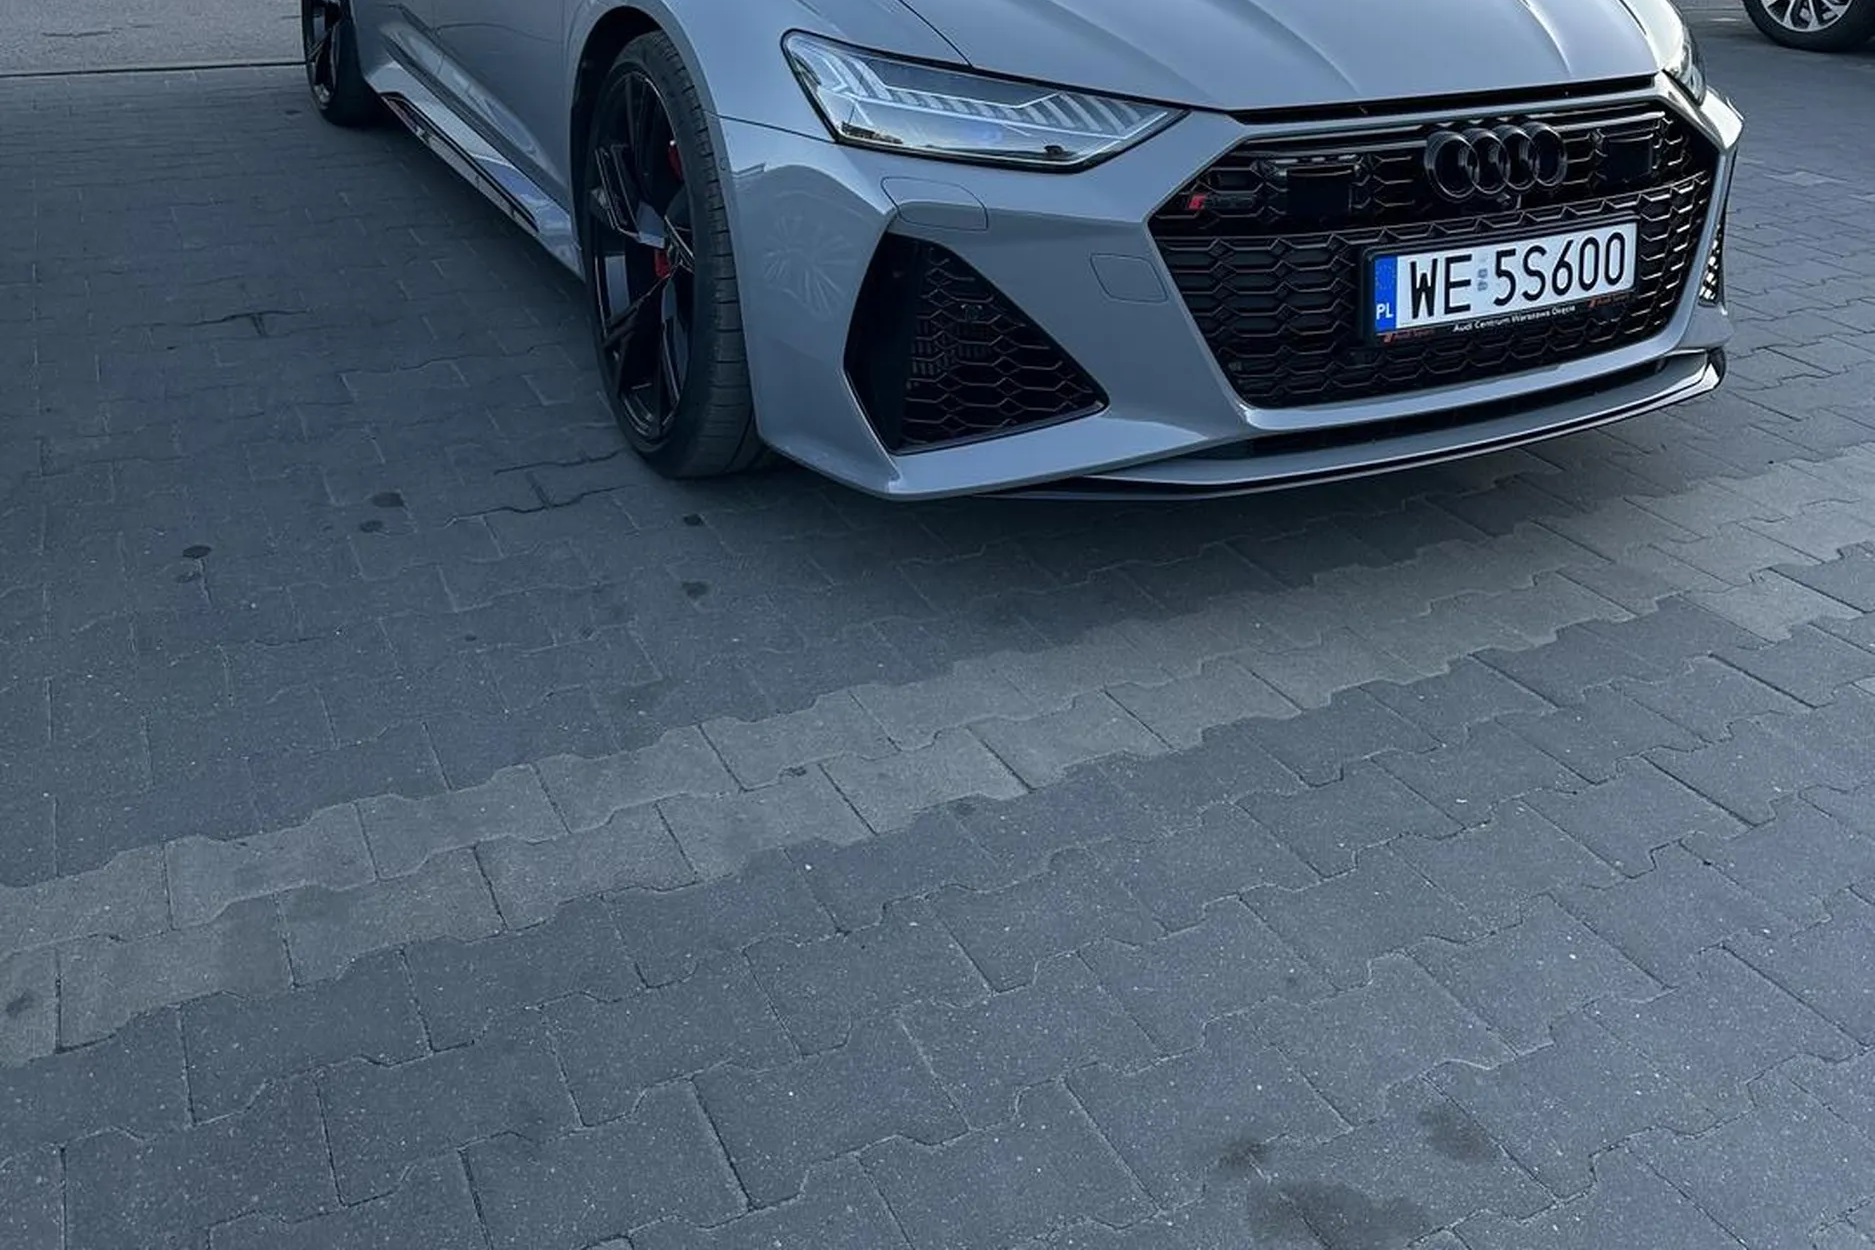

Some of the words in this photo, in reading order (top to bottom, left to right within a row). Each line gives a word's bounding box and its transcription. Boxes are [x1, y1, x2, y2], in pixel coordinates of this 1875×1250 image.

[1376, 302, 1395, 320] PL
[1409, 252, 1473, 320] WE
[1493, 231, 1626, 307] 5S600
[1452, 322, 1473, 333] Audi
